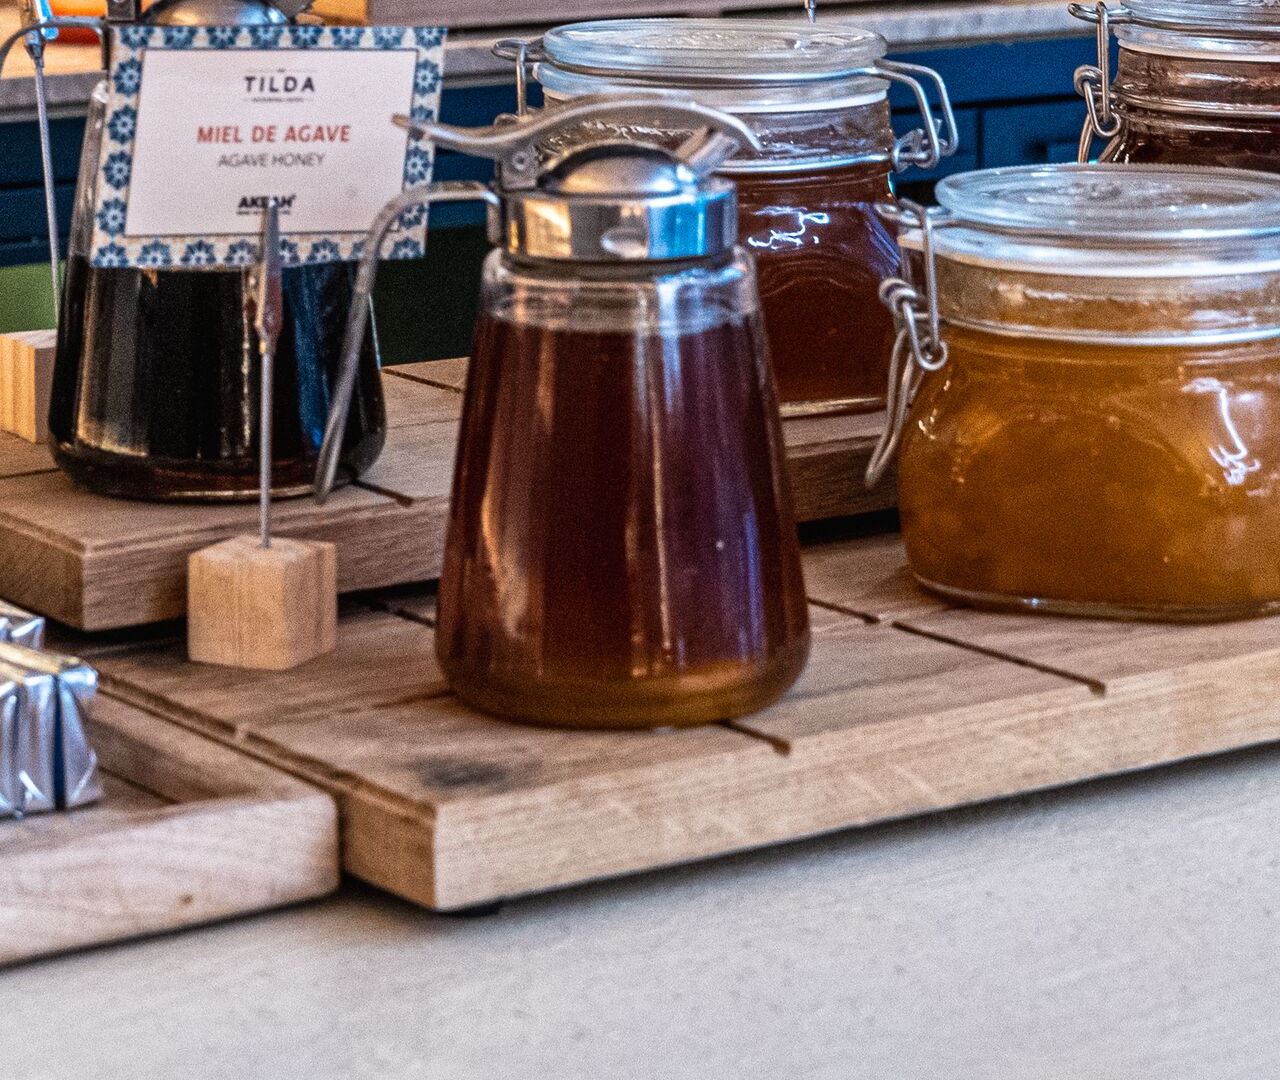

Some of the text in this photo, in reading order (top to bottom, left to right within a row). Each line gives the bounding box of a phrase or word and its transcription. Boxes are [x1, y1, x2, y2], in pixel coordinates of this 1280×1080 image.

[244, 75, 316, 93] TILDA
[197, 124, 351, 144] MIEL DE AGAVE
[218, 152, 326, 168] AGAVE HONEY
